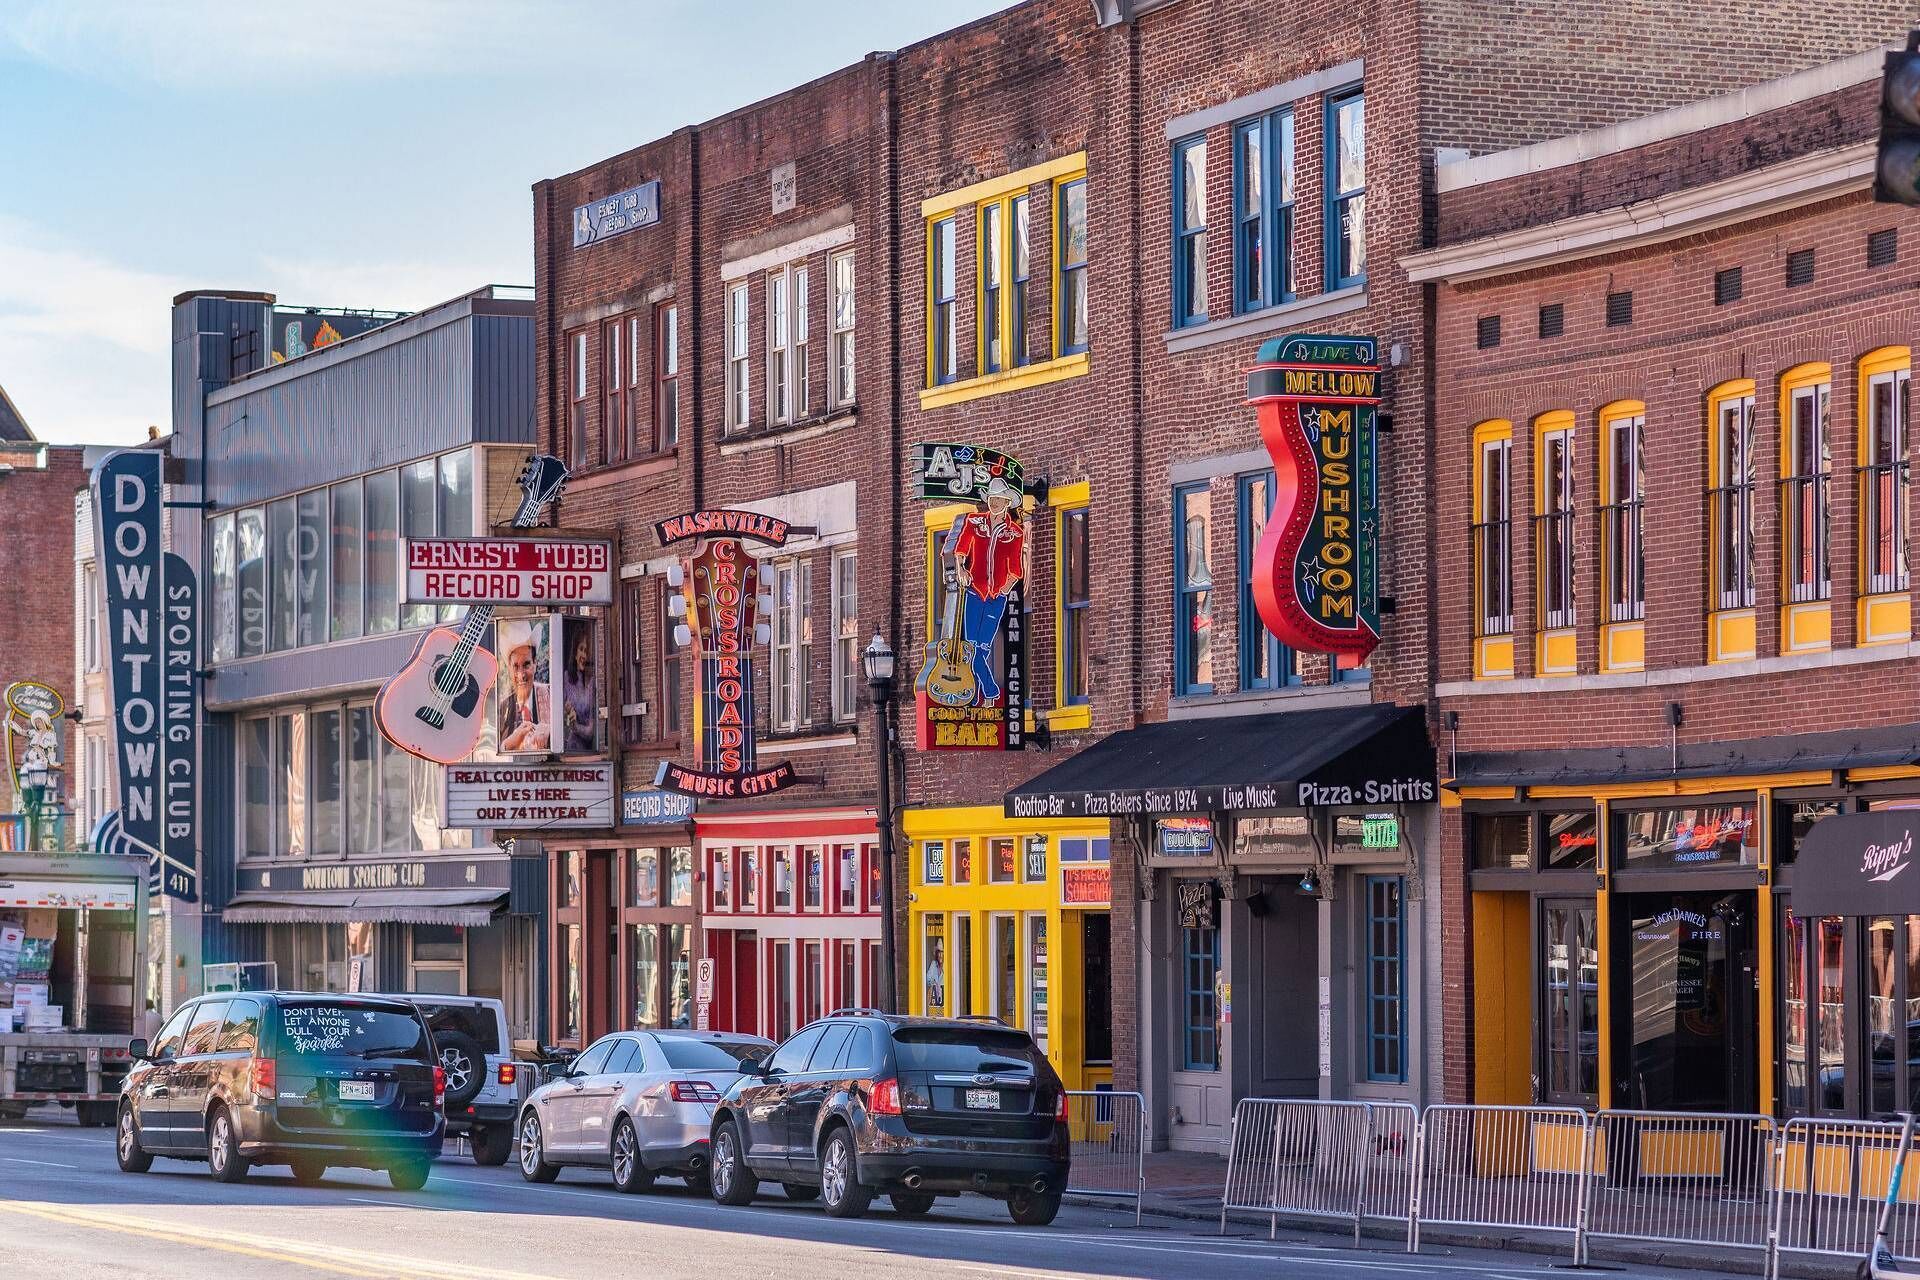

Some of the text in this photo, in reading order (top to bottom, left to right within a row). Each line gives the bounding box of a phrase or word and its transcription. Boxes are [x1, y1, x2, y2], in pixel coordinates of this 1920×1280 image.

[1312, 346, 1350, 360] LIVE
[1285, 371, 1375, 396] MELLOW
[1320, 409, 1353, 618] MUSHROOM
[662, 511, 787, 543] NASHVILLE
[411, 542, 605, 569] ERNEST TUBB
[426, 573, 593, 599] RECORD SHOP
[114, 474, 156, 822] DOWNTOWN
[713, 540, 743, 773] CROSSROADS
[1008, 590, 1020, 745] ALAN JACKSON
[168, 585, 192, 839] SPORTING CLUB
[936, 722, 999, 746] BAR
[455, 769, 604, 783] REAL COUNTRY MUSIC
[488, 788, 571, 801] LIVES HERE
[1014, 785, 1276, 817] Rooftop Bar Pizza Bakers Since 1974 Live Music
[1299, 778, 1433, 806] Pizza Spirits
[477, 807, 506, 820] OUR
[549, 806, 587, 819] YEAR
[624, 794, 690, 819] RECORD SHOP
[1861, 829, 1912, 874] Rippy's
[169, 873, 190, 894] 411
[303, 862, 425, 890] DOWNTOWN SPORTING CLUB
[1652, 907, 1706, 928] JACK DANIEL'S
[1691, 931, 1721, 939] FIRE
[285, 1017, 350, 1027] LET ANYONE
[286, 1027, 350, 1036] DULL YOUR
